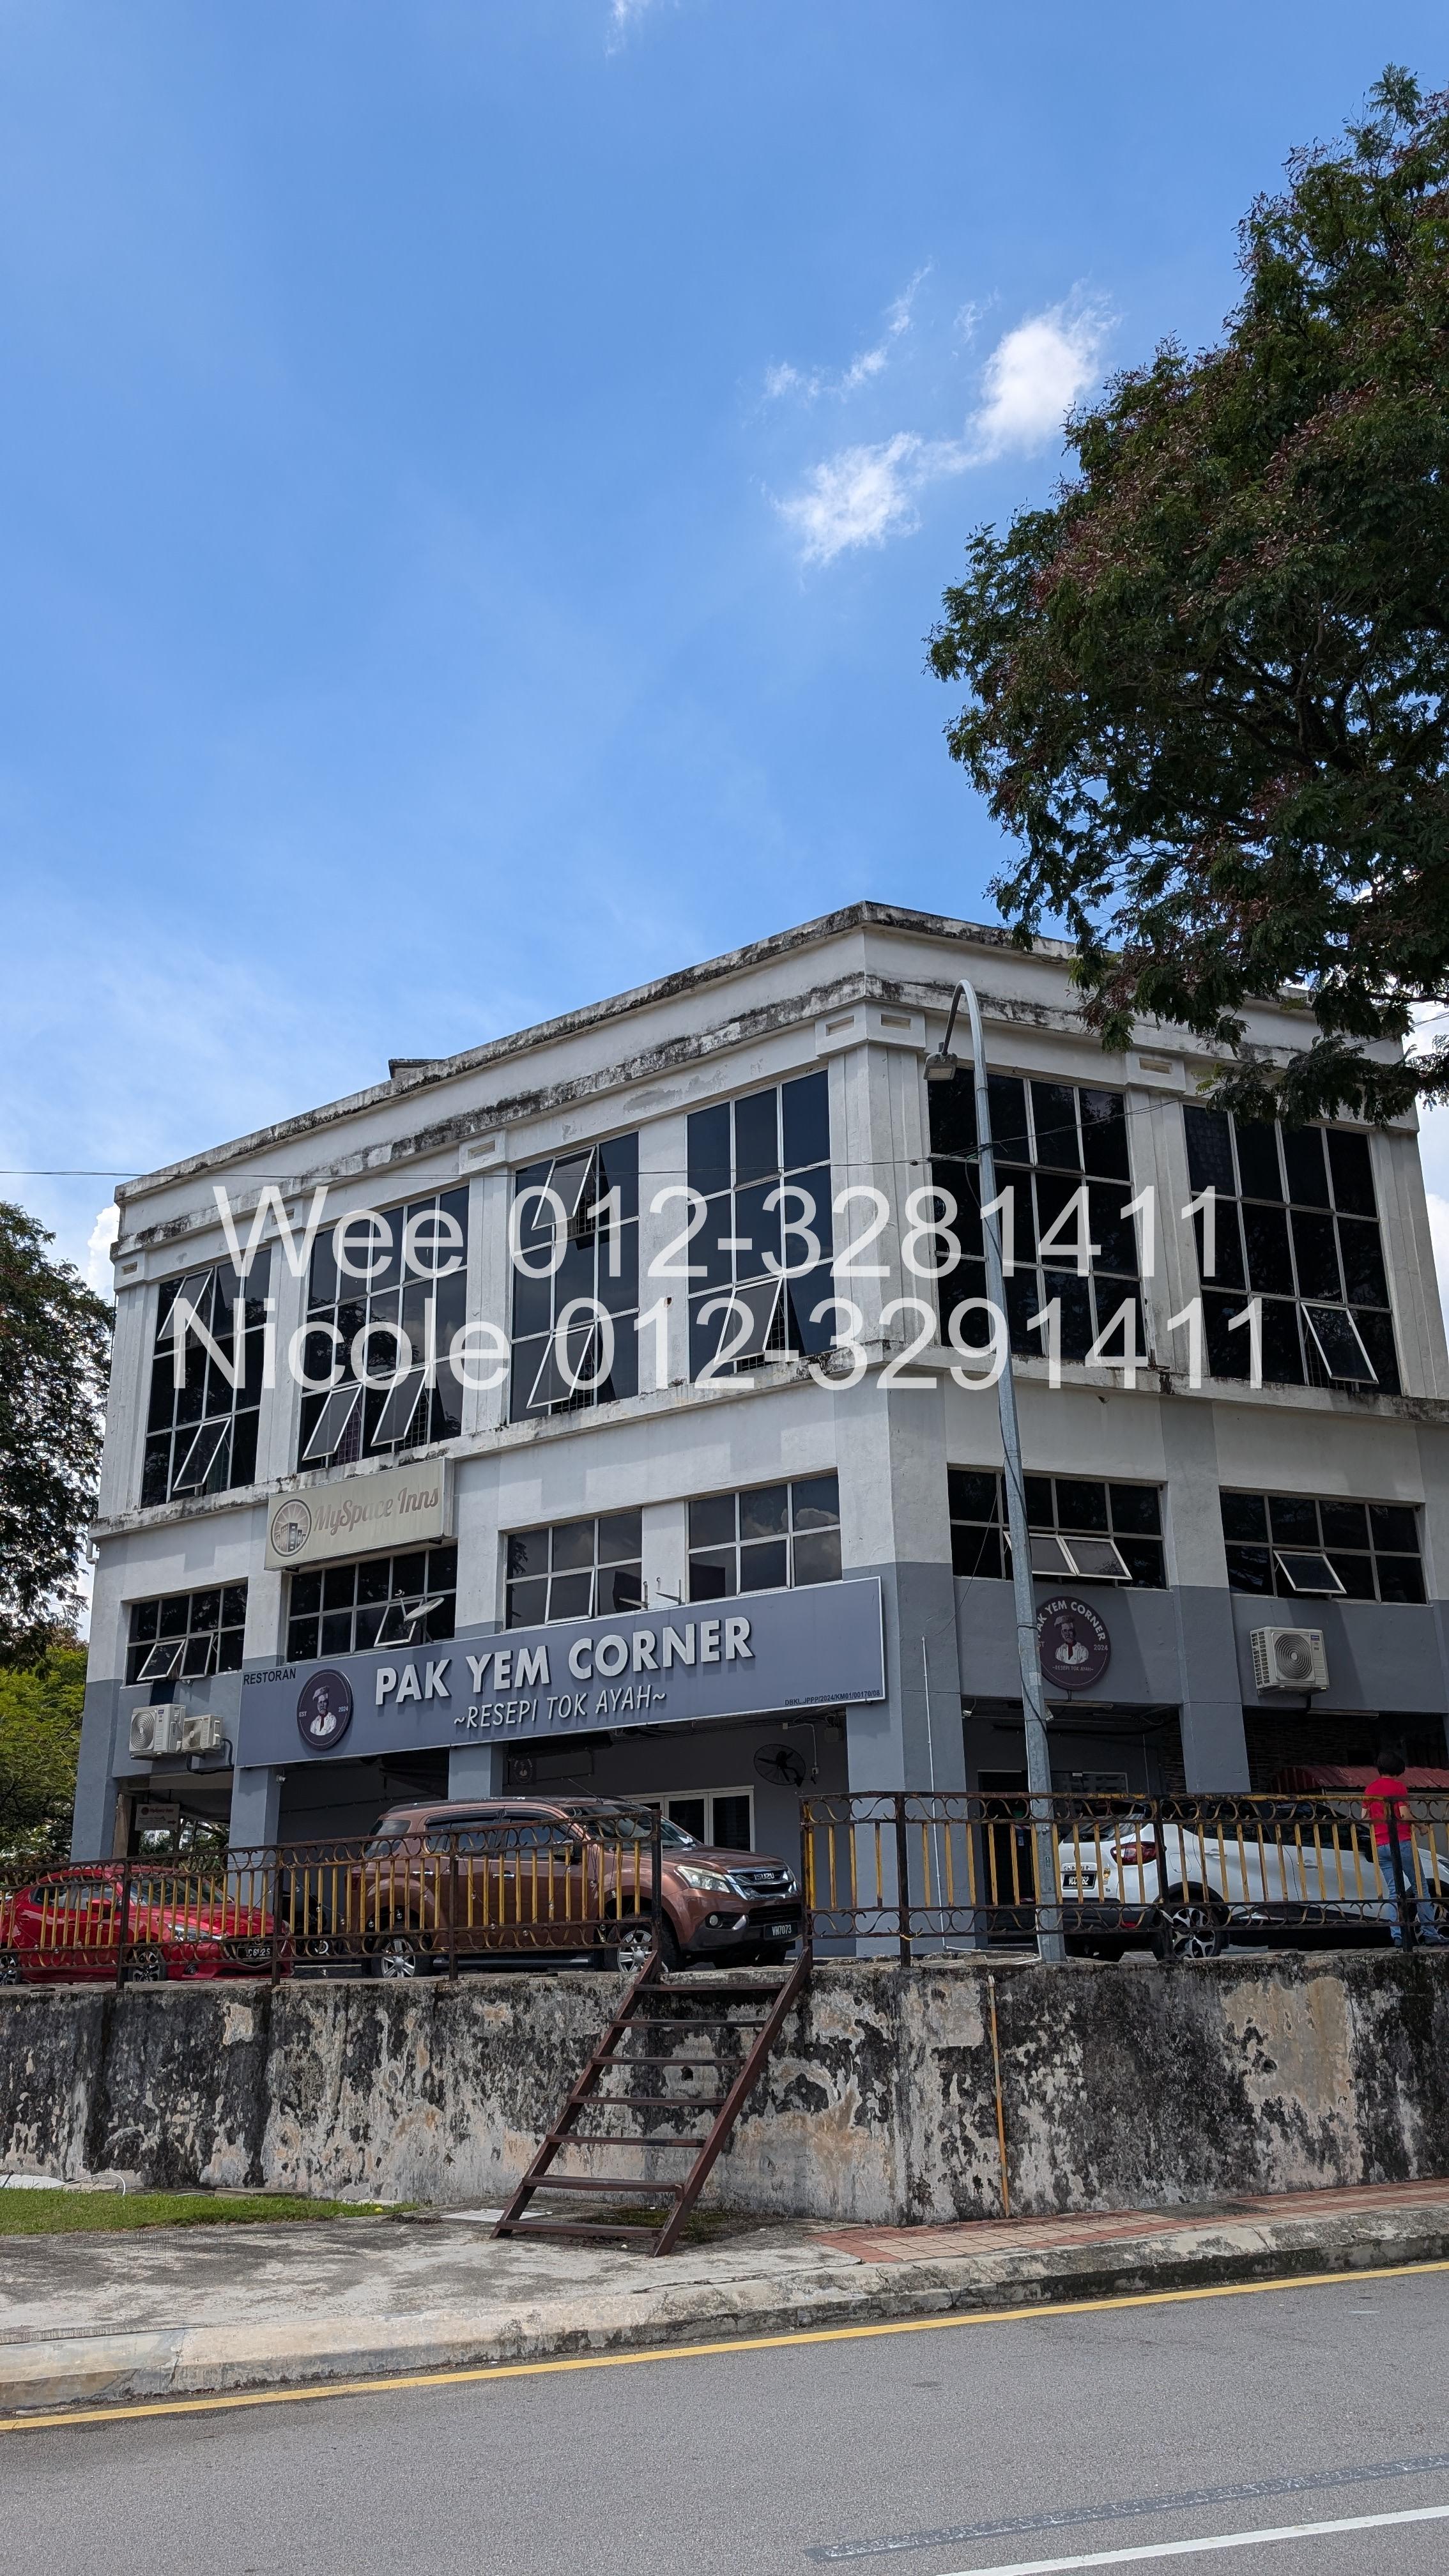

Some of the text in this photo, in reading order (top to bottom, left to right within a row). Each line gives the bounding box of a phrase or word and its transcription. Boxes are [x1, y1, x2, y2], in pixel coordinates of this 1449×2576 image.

[314, 1487, 439, 1536] MySpace Inns
[1045, 1600, 1068, 1615] YEM
[1070, 1601, 1107, 1641] CORNER
[243, 1667, 296, 1685] RESTORAN
[375, 1616, 755, 1705] PAK YEM CORNER
[547, 1692, 588, 1720] TOK
[754, 1872, 775, 1880] ISUZU
